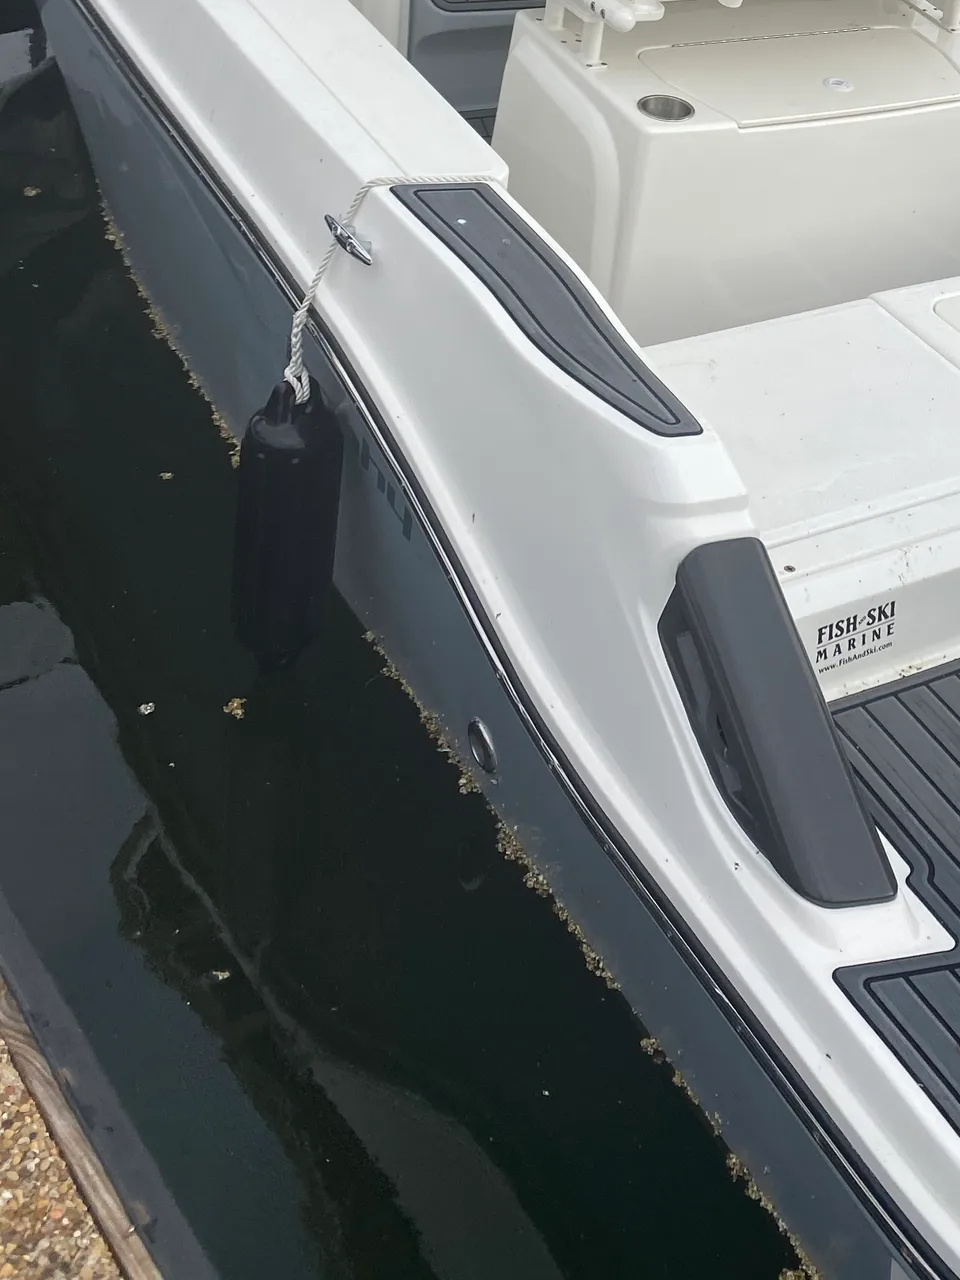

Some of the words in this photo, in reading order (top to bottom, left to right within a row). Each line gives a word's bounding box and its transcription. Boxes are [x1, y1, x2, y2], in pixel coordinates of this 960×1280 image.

[815, 622, 895, 664] MARINE
[817, 614, 858, 645] FISH
[866, 600, 896, 626] SKI
